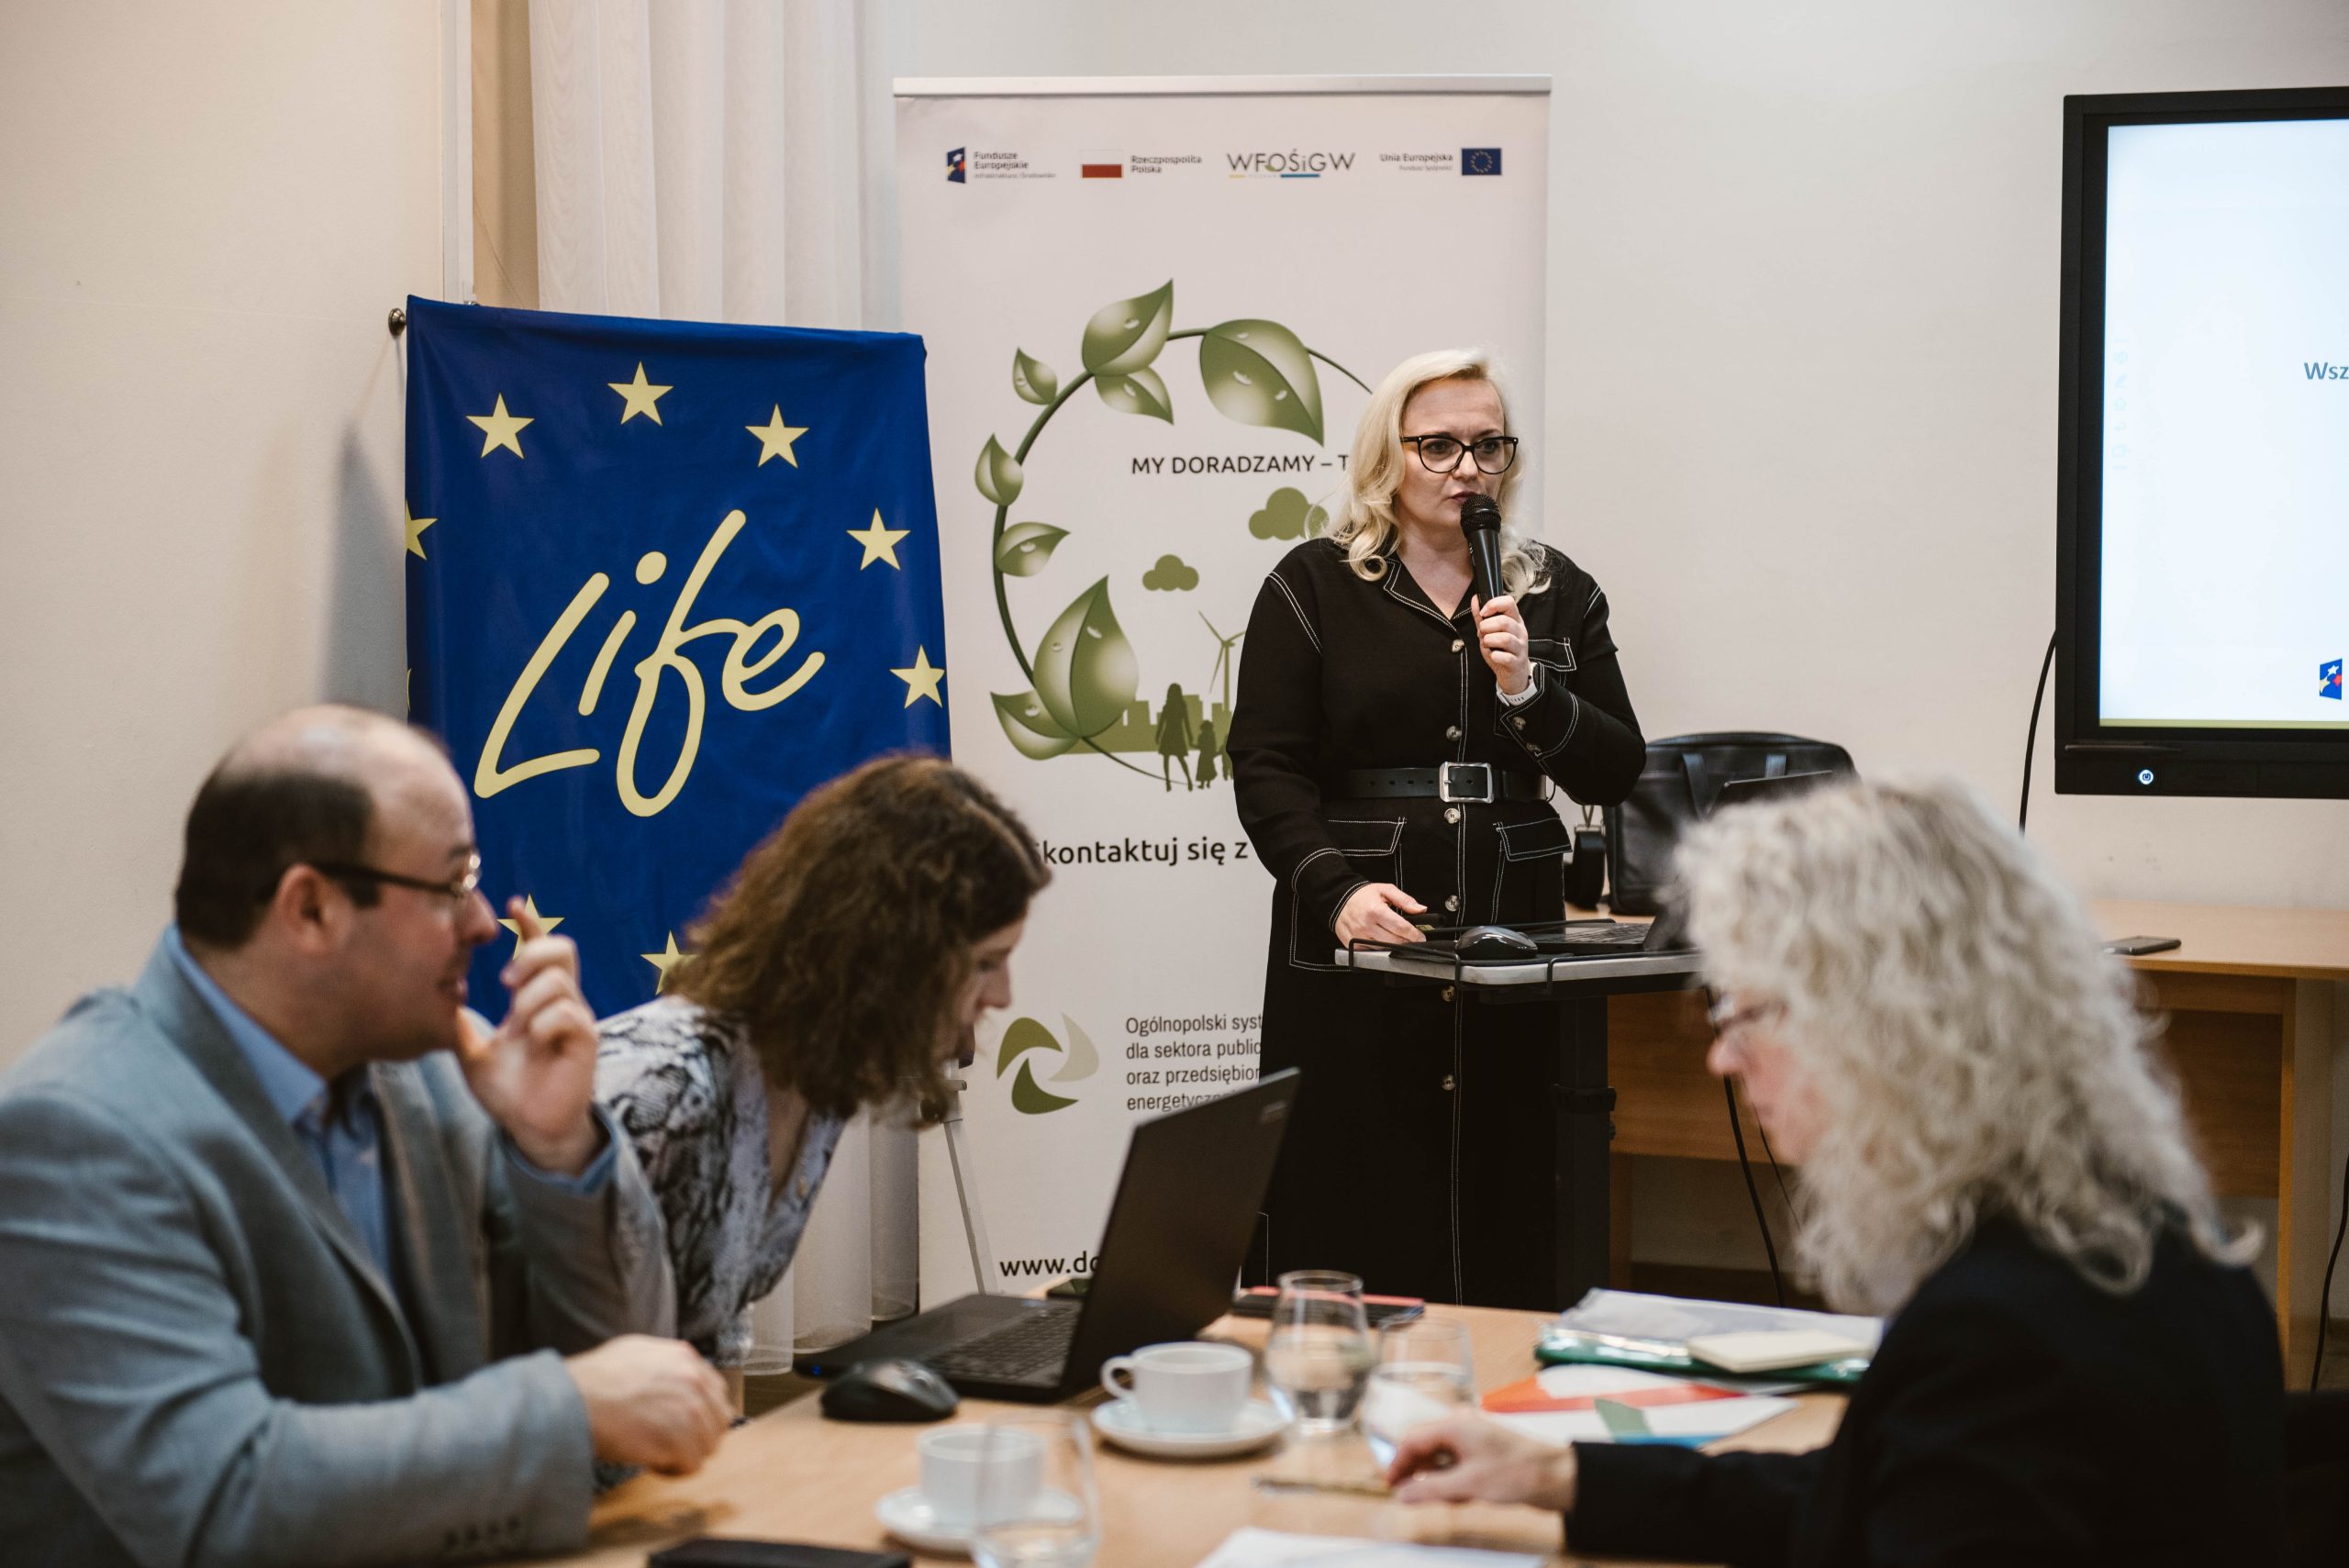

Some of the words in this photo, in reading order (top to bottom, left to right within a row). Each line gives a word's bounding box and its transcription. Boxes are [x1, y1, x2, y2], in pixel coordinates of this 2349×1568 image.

[974, 151, 1019, 160] Fundusze
[1130, 155, 1202, 164] Rzeczpospolita
[1227, 149, 1356, 172] WFOŚiGW
[1380, 153, 1401, 161] Unia
[1403, 153, 1453, 163] Europejska
[974, 161, 1029, 170] Europejskie
[1130, 165, 1162, 173] Polska
[2303, 361, 2349, 381] Wsz
[1131, 457, 1164, 474] MY
[1171, 455, 1315, 474] DORADZAMY
[474, 510, 825, 817] Life
[1034, 837, 1177, 866] kontaktuj
[1187, 836, 1225, 865] się
[1234, 841, 1249, 859] z
[1126, 1014, 1227, 1037] Ogólnopolski
[1126, 1042, 1149, 1059] dla
[1154, 1040, 1211, 1058] sektora
[1127, 1071, 1160, 1084] oraz
